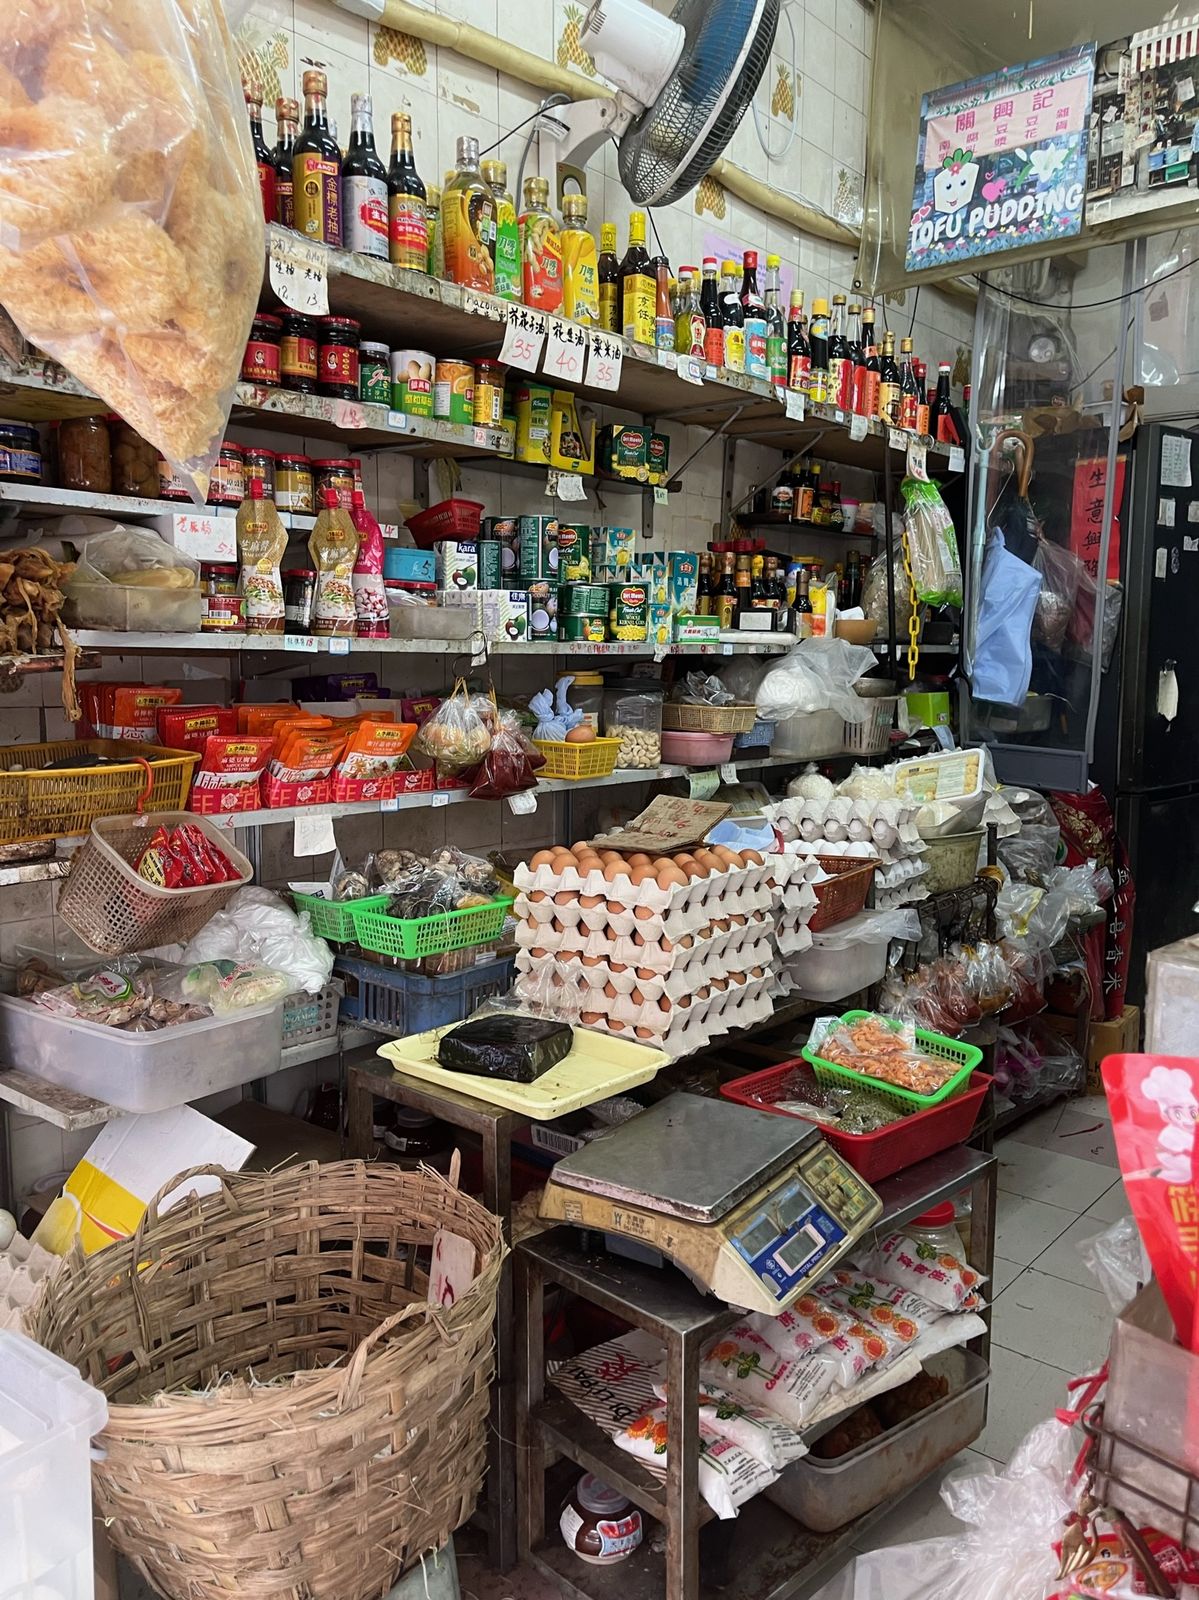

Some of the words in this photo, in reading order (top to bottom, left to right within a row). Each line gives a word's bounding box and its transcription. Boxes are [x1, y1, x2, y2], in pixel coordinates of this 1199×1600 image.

[909, 213, 962, 251] TOFU
[969, 182, 1084, 234] PUDDING
[511, 338, 536, 362] 35
[555, 350, 578, 374] 40
[596, 362, 615, 382] 35
[458, 543, 475, 553] kara
